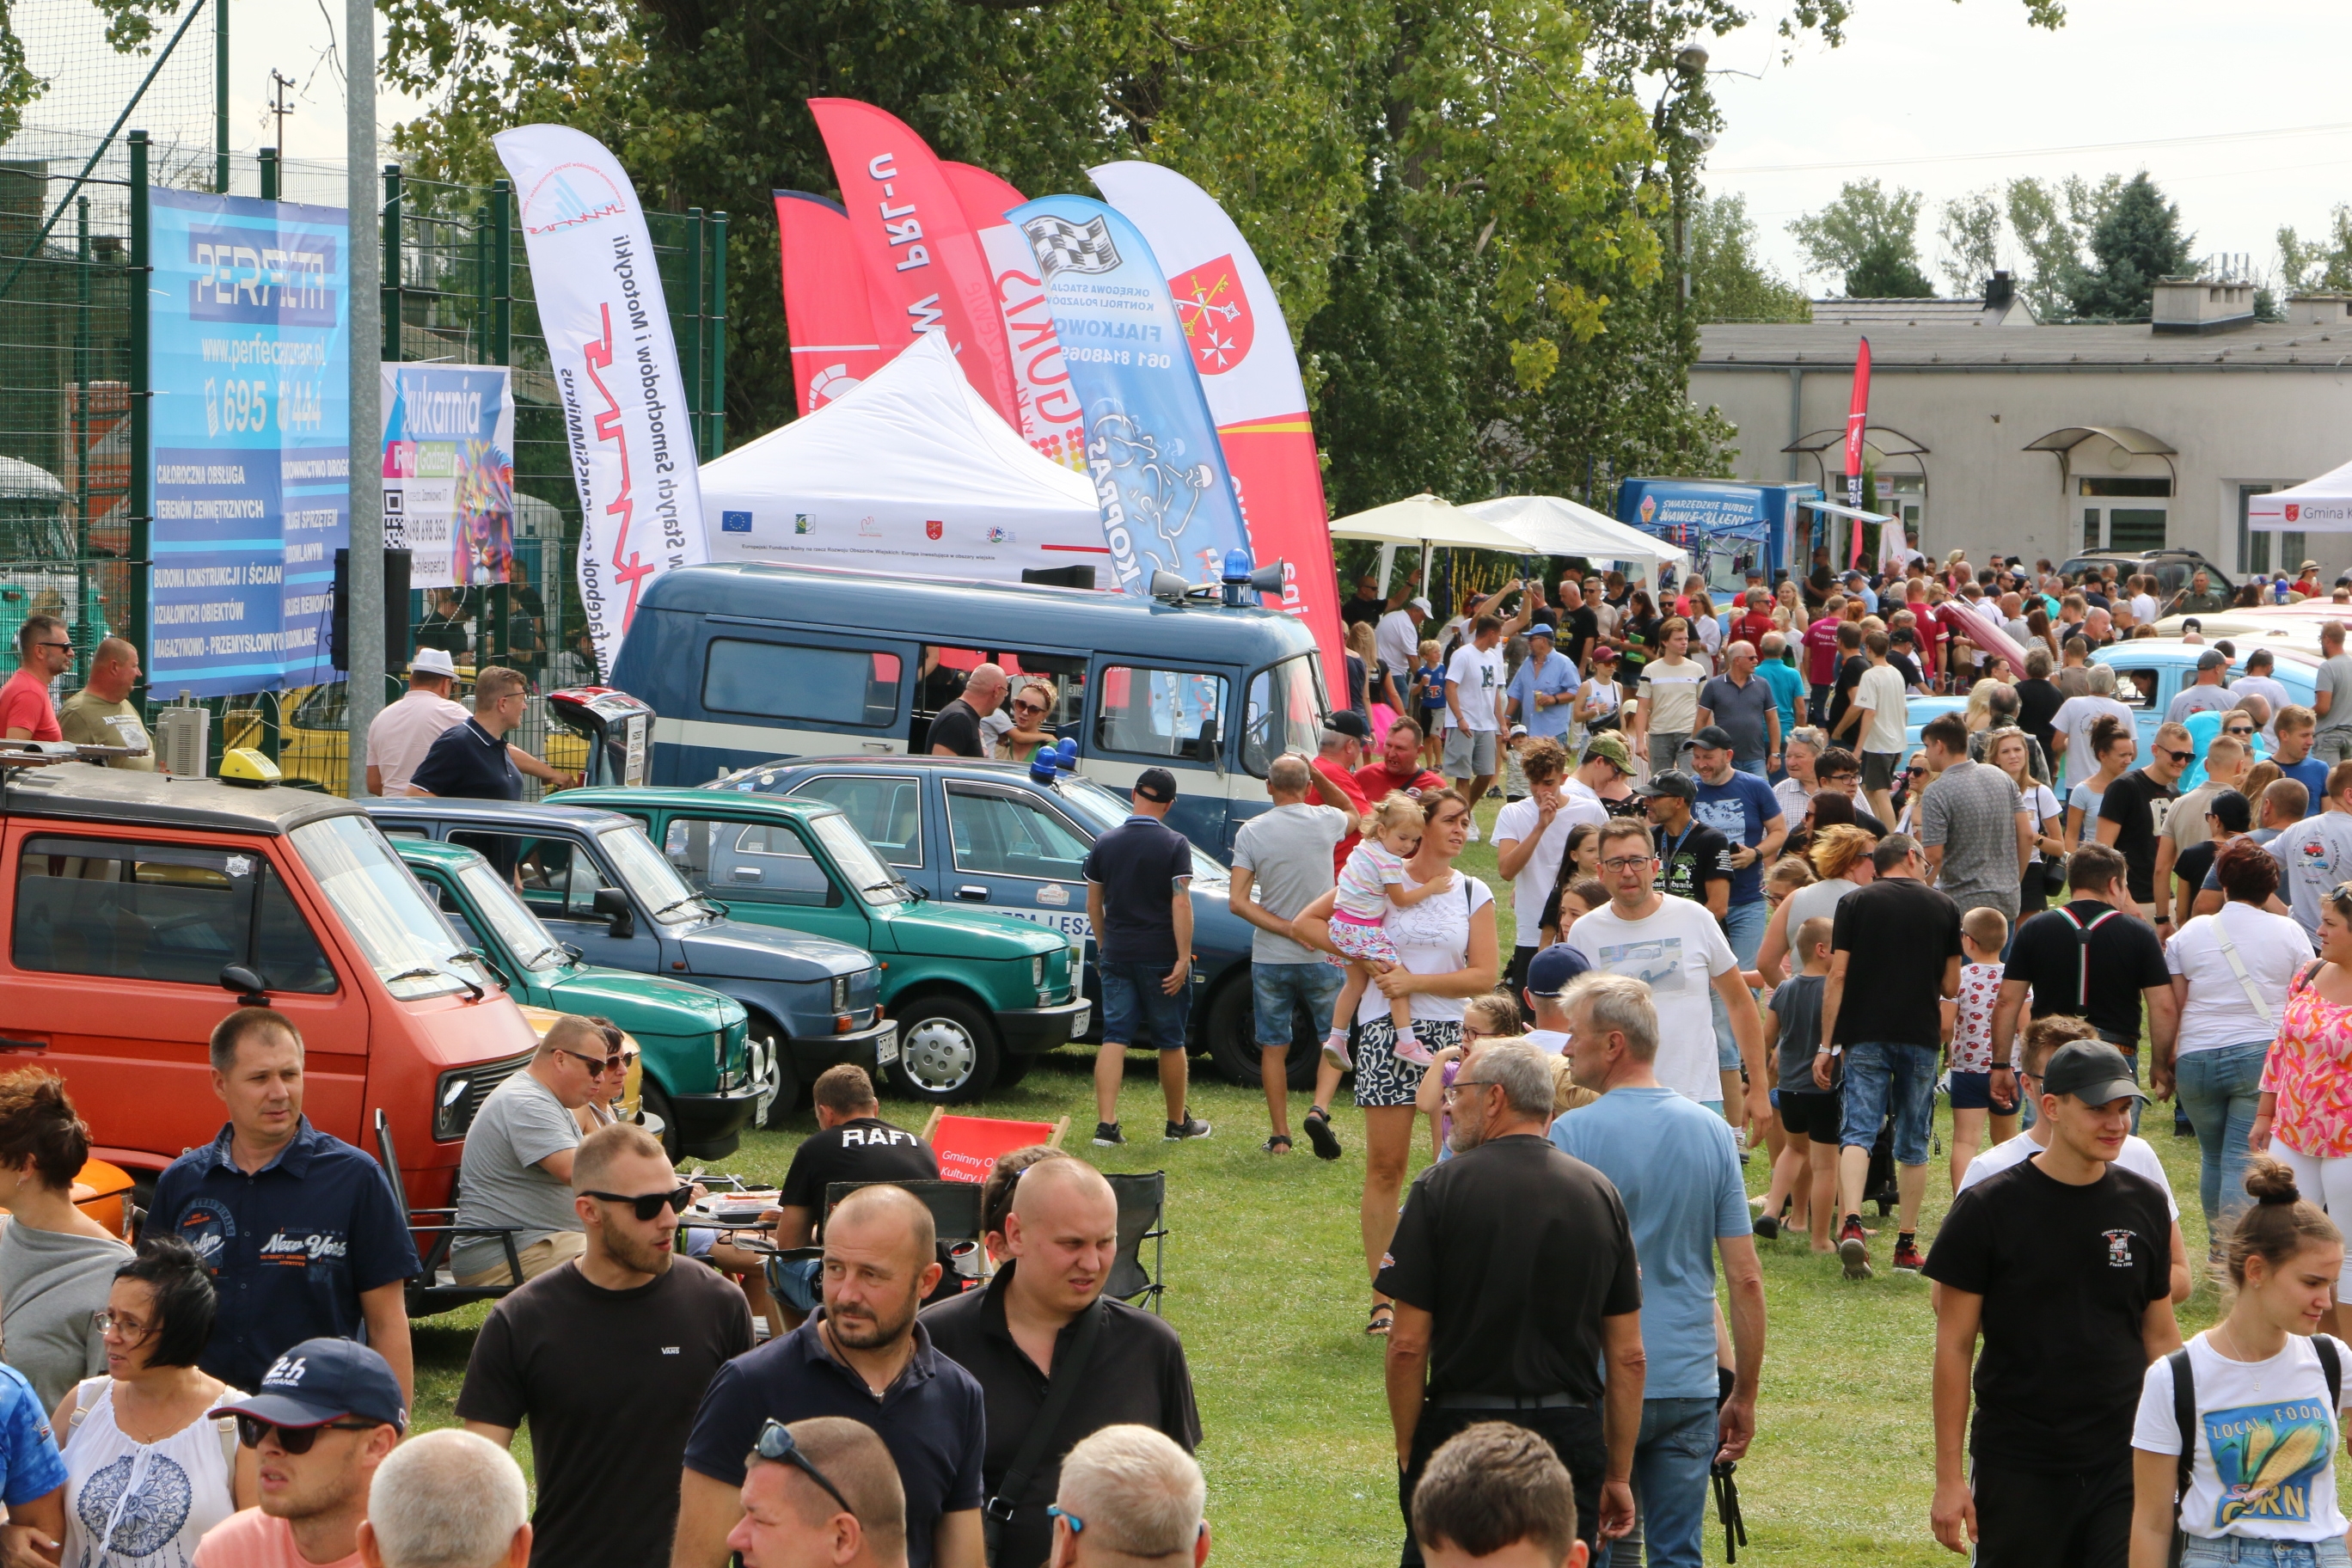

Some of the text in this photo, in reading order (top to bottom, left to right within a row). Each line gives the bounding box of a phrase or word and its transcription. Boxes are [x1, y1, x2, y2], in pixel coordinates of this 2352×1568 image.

[224, 379, 266, 432] 695
[420, 445, 451, 475] Gadżety
[156, 465, 245, 485] CAŁOROCZNA OBSŁUGA
[156, 496, 264, 524] TERENÓW ZEWNĘTRZNYCH
[1663, 499, 1755, 514] SWARZĘDZKIE BUBBLE
[2304, 507, 2343, 519] Gmina
[302, 509, 337, 532] SPRZĘTEM
[154, 561, 281, 588] BUDOWA KONSTRUKCJI I ŚCIAN
[155, 597, 244, 624] DZIAŁOWYCH OBIEKTÓW
[154, 638, 205, 658] MAGAZYNOWO
[942, 1150, 982, 1167] Gminny
[940, 1167, 977, 1182] Kultury
[260, 1233, 347, 1259] New York
[662, 1346, 680, 1355] VANS
[2213, 1406, 2321, 1439] LOCAL FOOD
